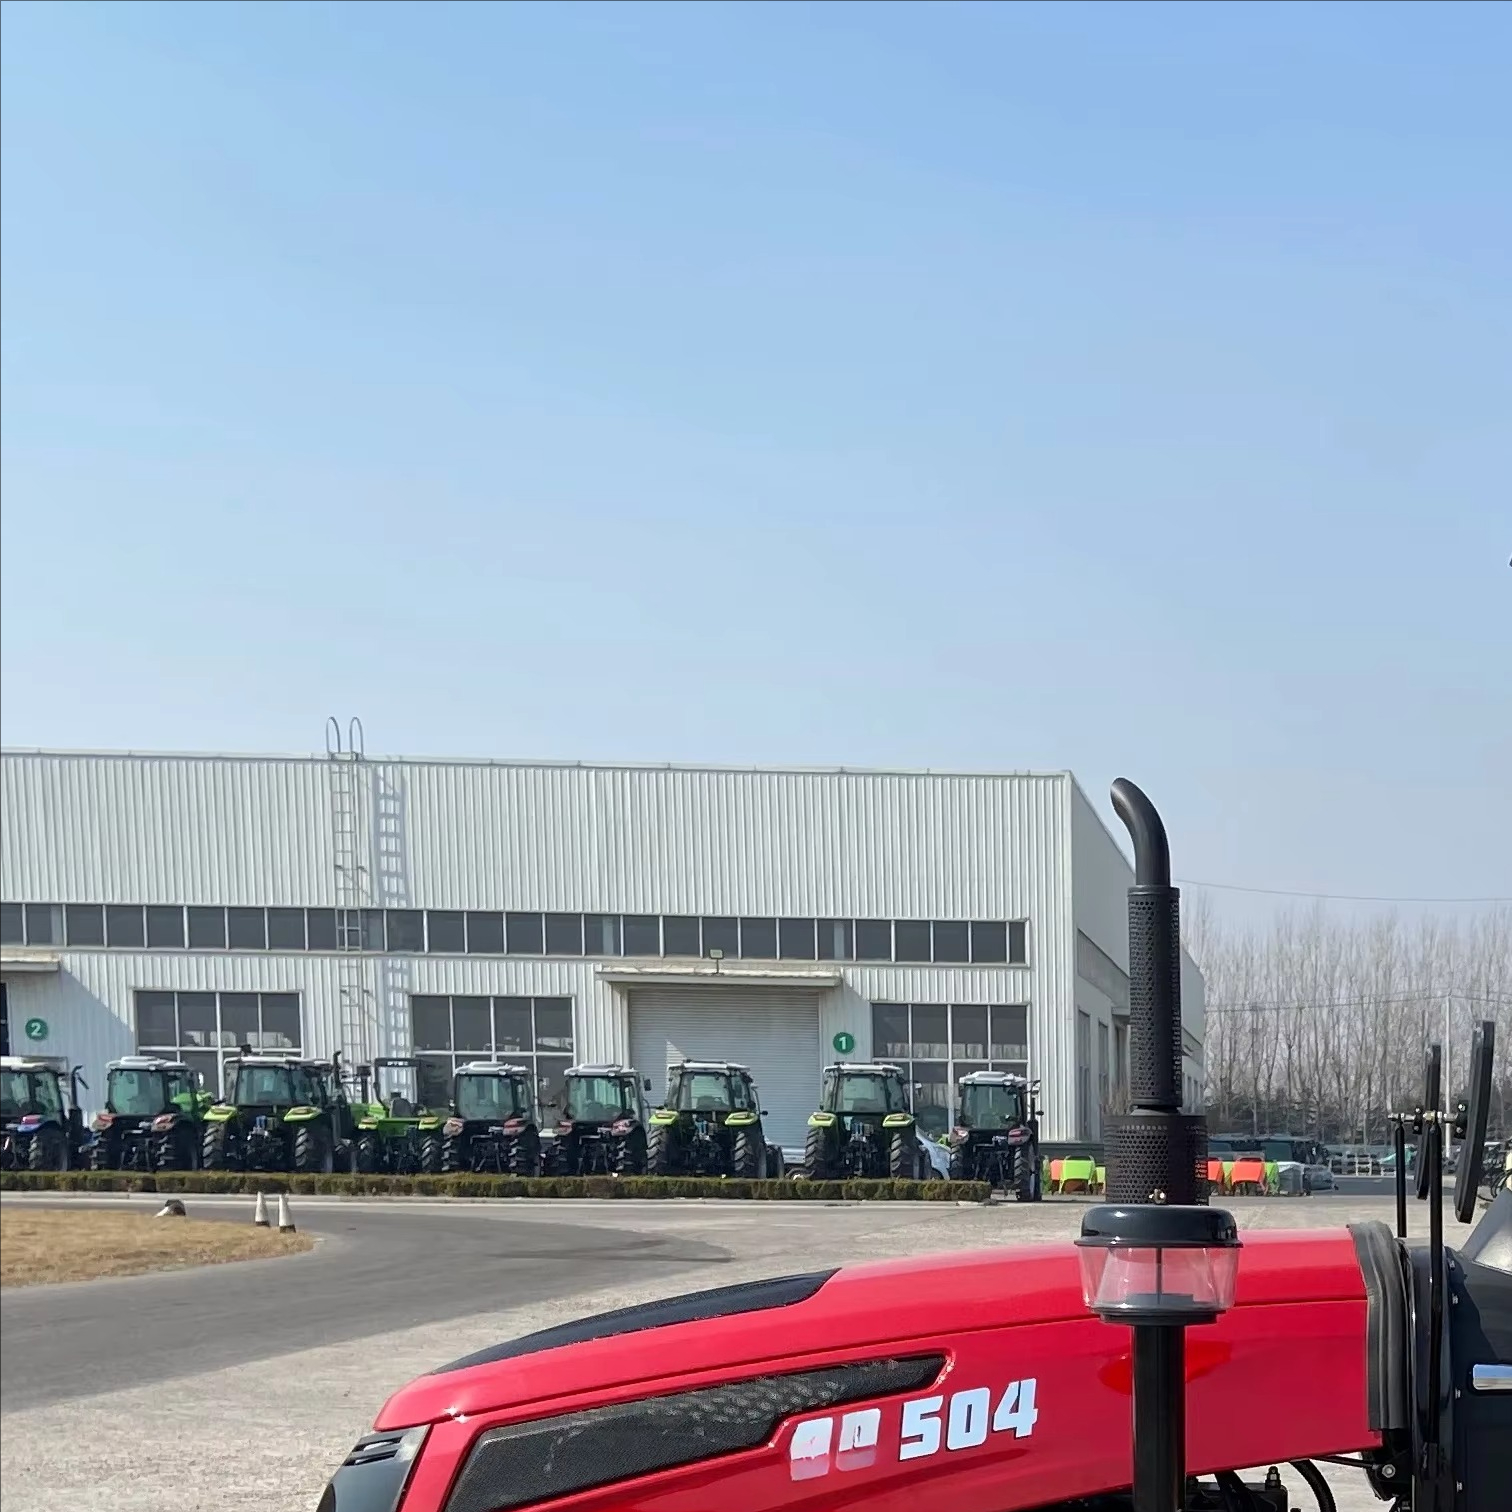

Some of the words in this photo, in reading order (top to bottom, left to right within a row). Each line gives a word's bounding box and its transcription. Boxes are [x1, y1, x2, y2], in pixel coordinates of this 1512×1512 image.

[31, 1022, 42, 1037] 2
[838, 1036, 847, 1050] 1
[899, 1378, 1038, 1461] 504
